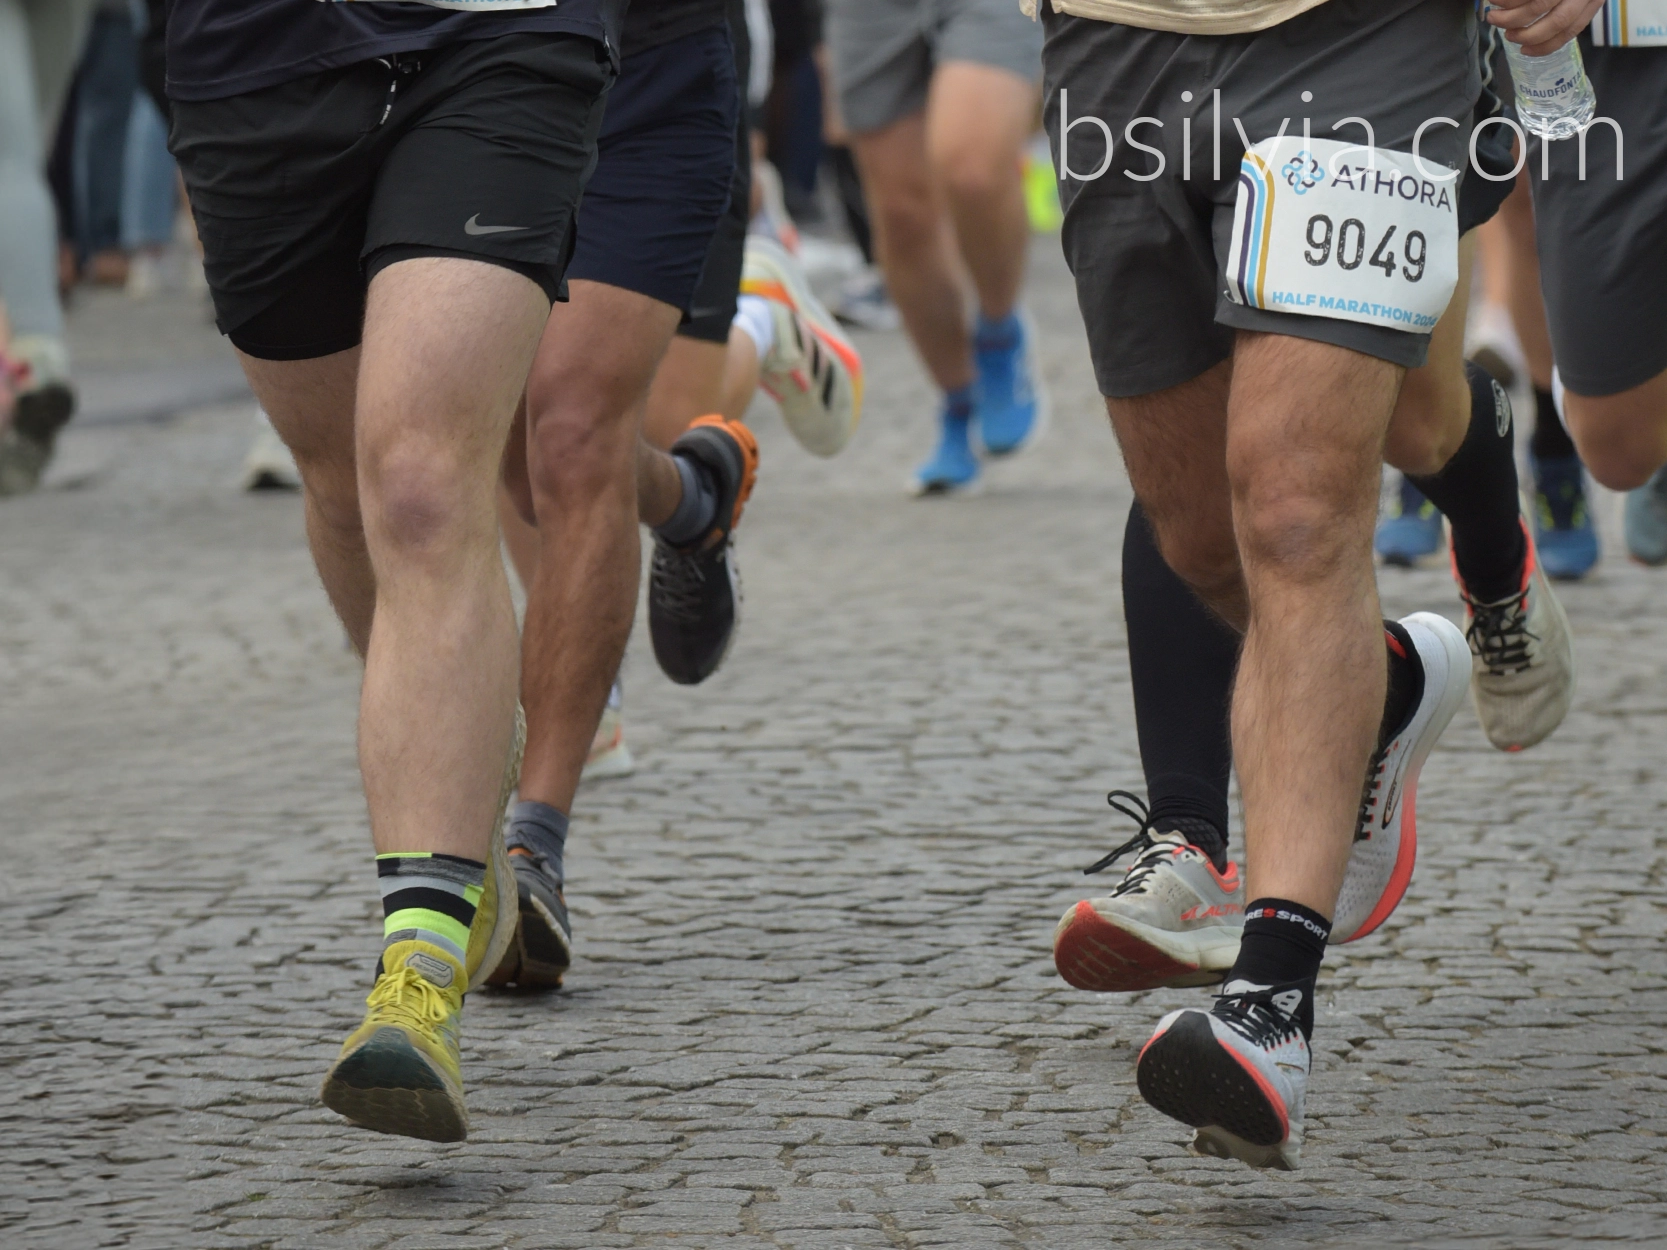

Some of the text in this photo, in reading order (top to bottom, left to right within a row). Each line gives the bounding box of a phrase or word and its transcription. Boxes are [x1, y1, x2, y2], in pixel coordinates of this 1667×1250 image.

[1636, 25, 1667, 37] HAL
[1519, 71, 1583, 99] CHAUDFONTA
[1331, 164, 1452, 213] ATHORA
[1304, 213, 1428, 283] 9049
[1272, 291, 1316, 307] HALF
[1319, 296, 1413, 324] MARATHON
[1201, 902, 1244, 919] ALTR
[1243, 907, 1328, 940] RESSPORT
